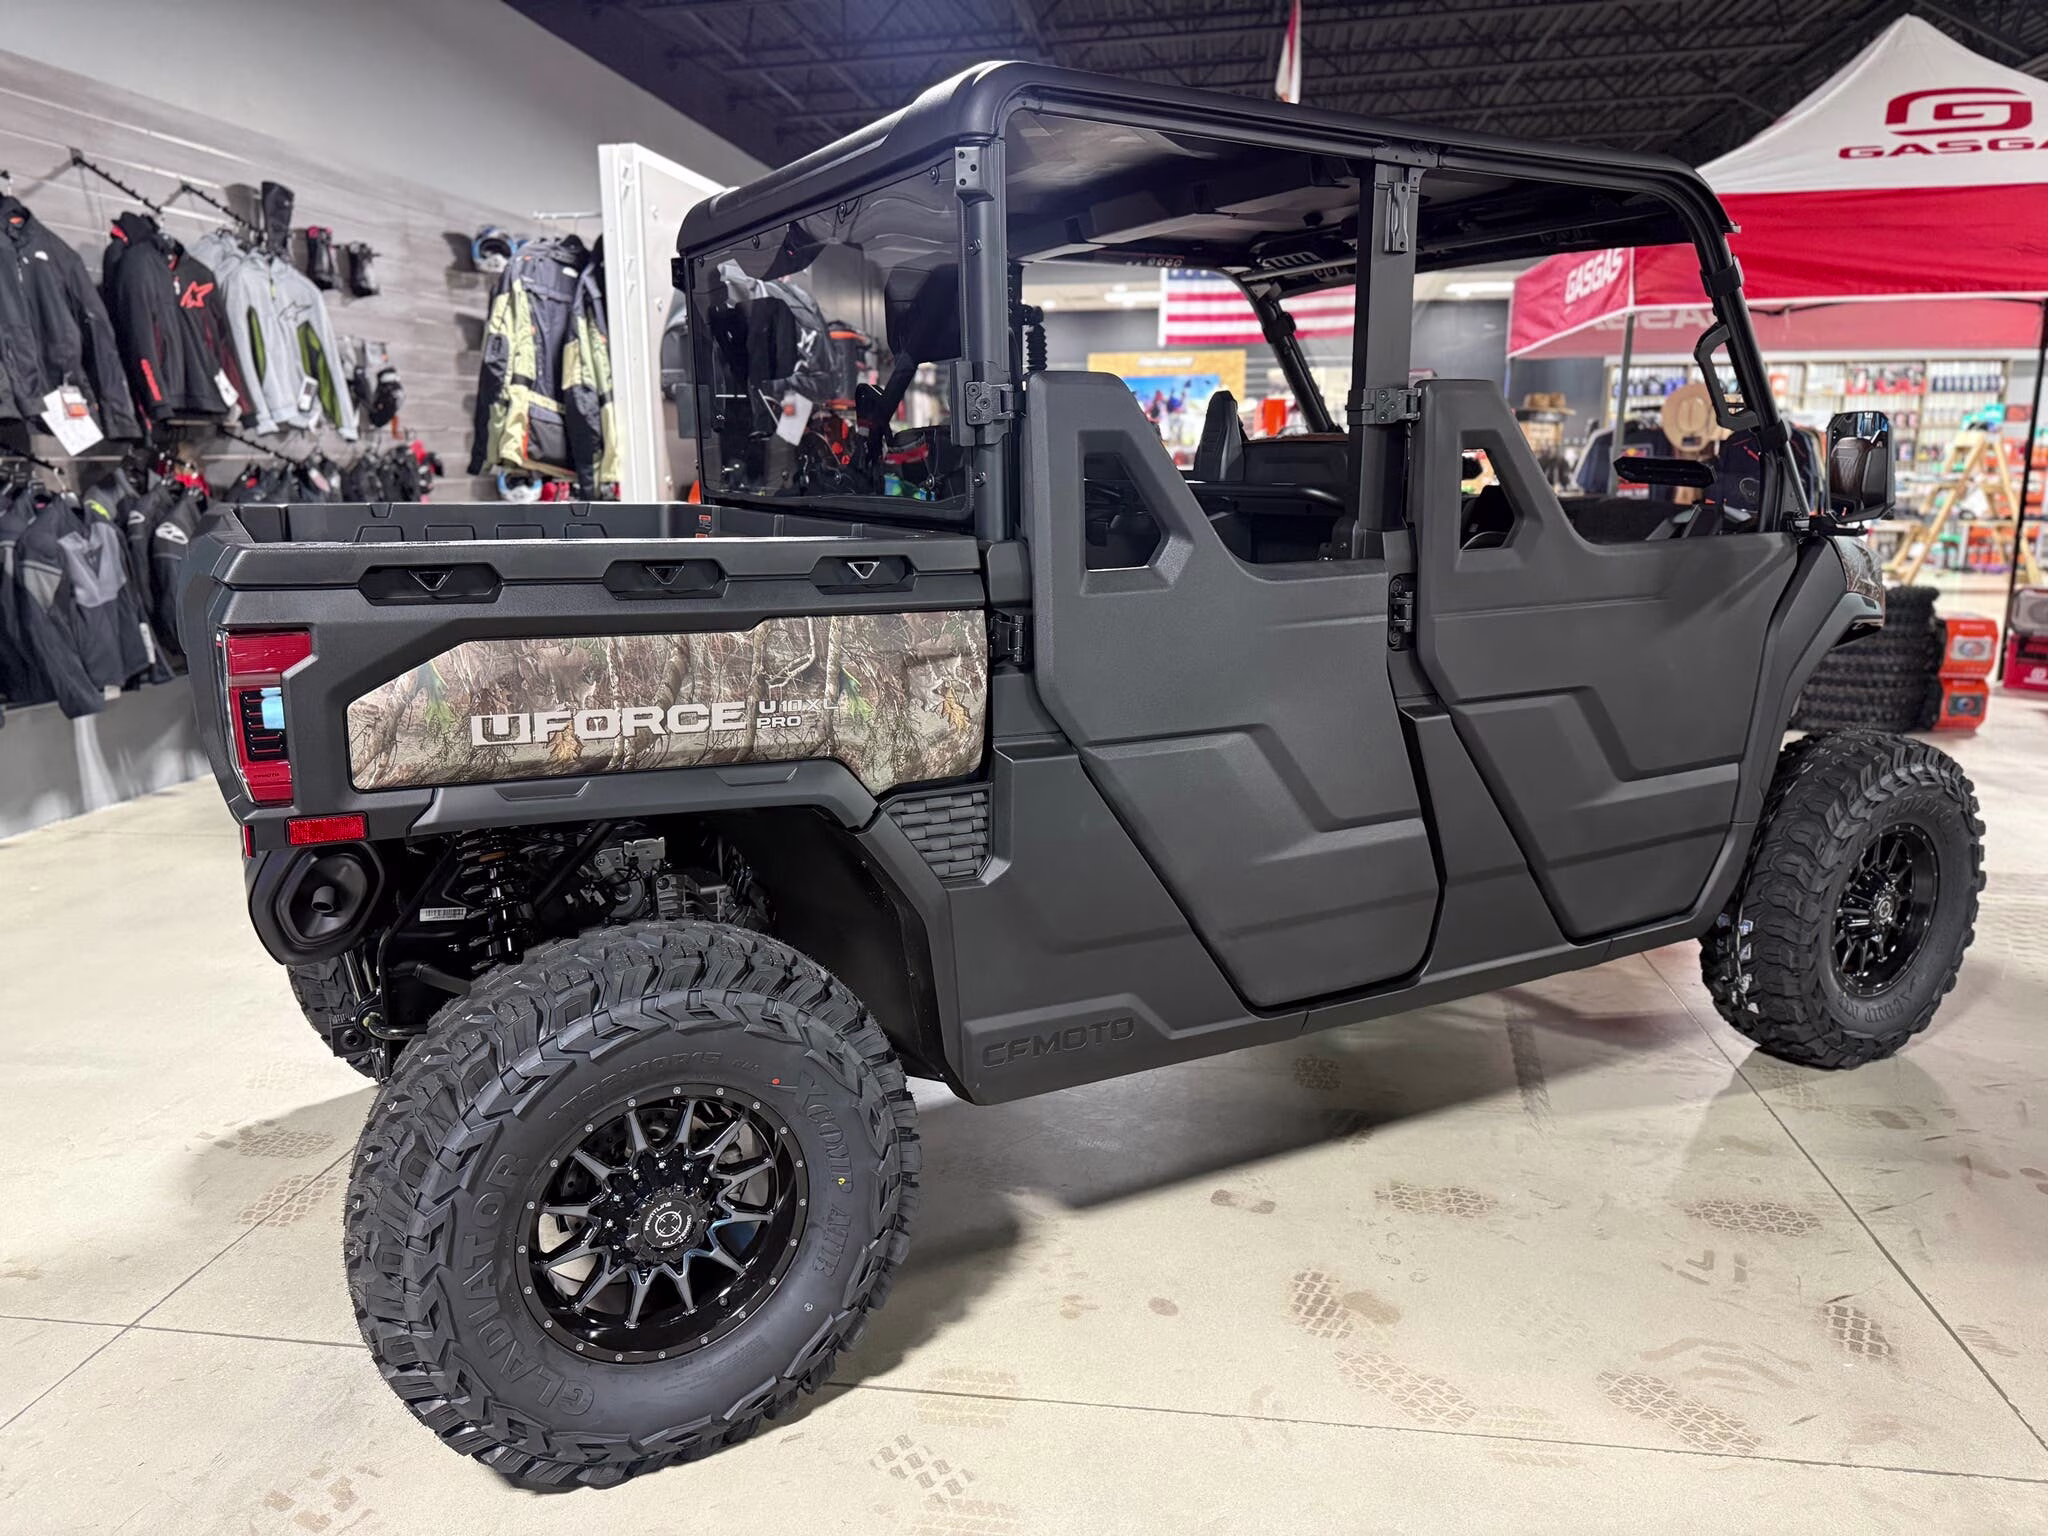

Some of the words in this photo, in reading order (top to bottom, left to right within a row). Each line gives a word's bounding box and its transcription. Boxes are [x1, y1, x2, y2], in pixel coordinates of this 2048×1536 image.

[1838, 136, 2048, 160] GASG
[1564, 247, 1625, 305] GASGAS
[471, 701, 748, 746] UFORCE
[756, 715, 802, 729] PRO
[982, 1016, 1135, 1068] CFMOTO
[462, 1152, 595, 1416] GLADIATOR
